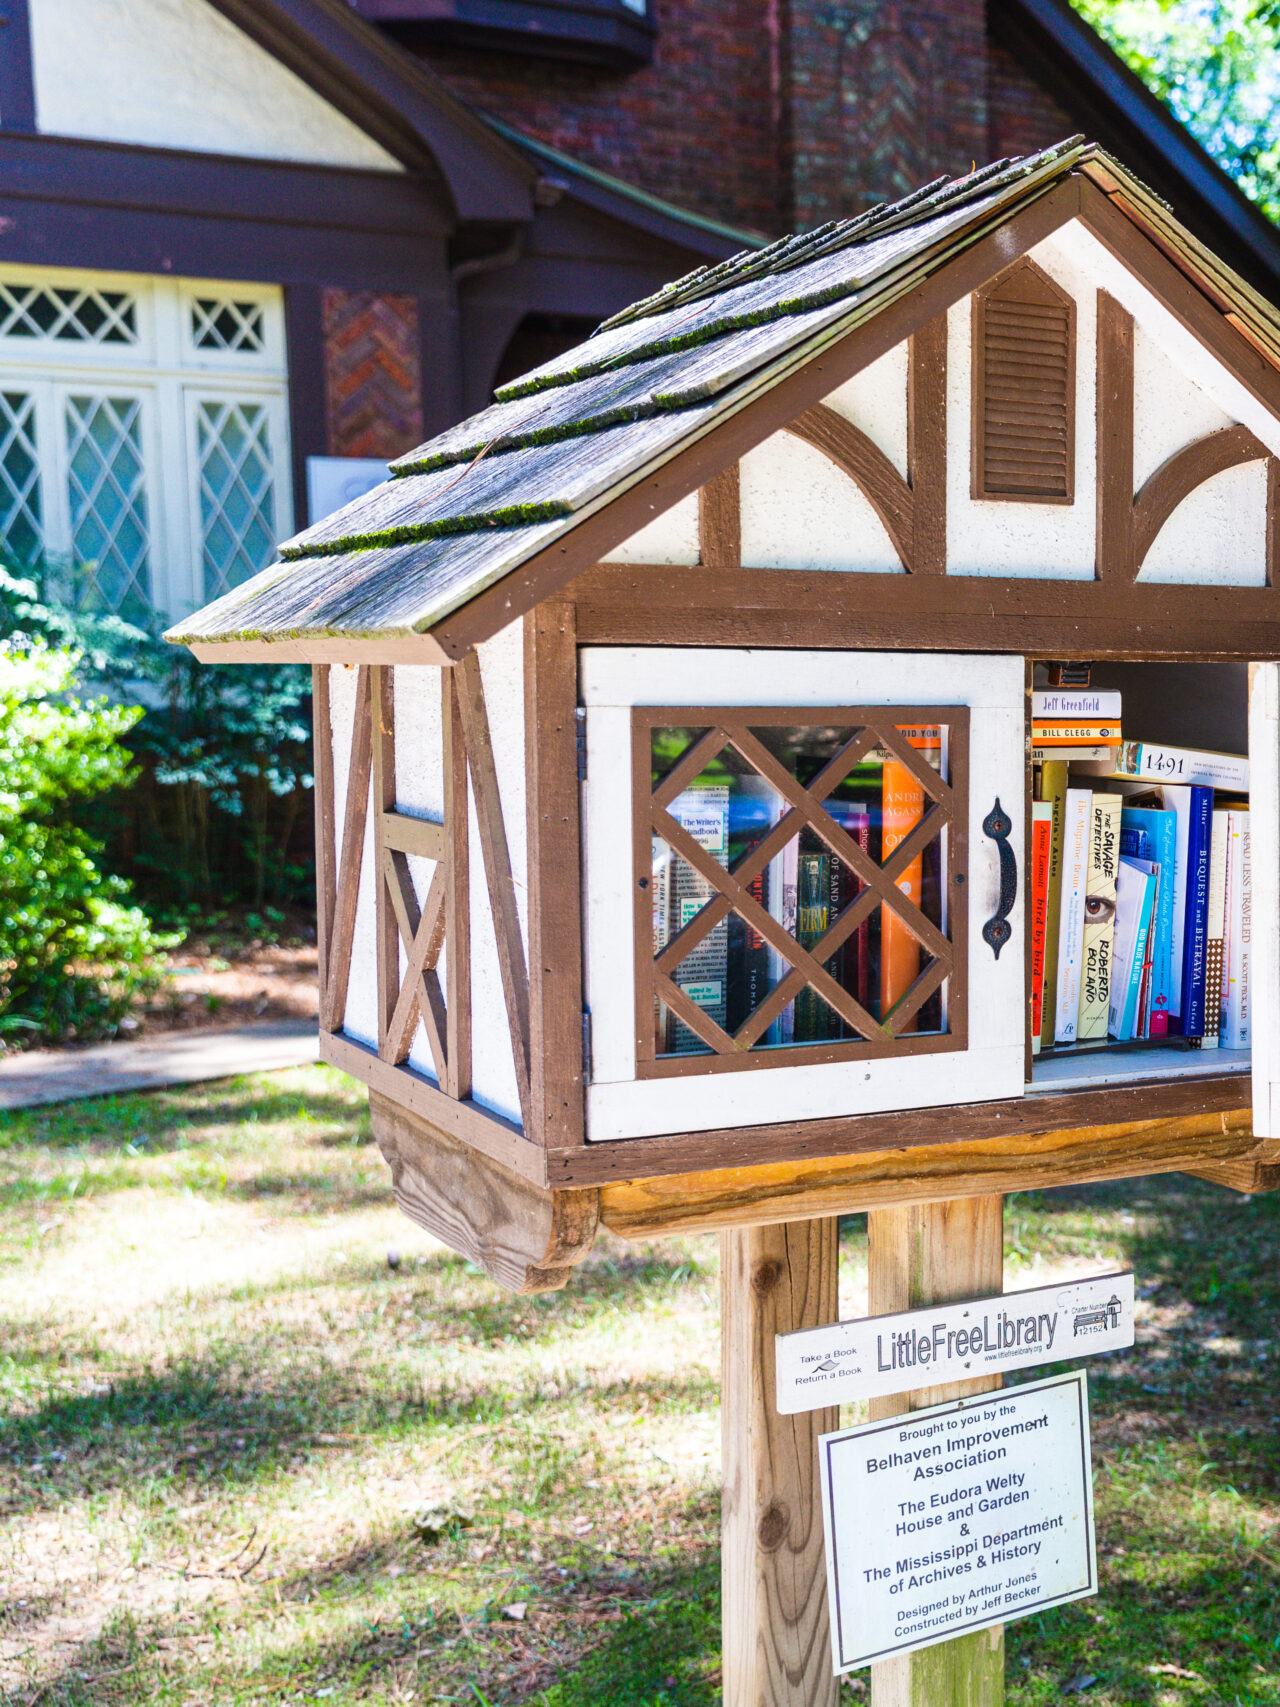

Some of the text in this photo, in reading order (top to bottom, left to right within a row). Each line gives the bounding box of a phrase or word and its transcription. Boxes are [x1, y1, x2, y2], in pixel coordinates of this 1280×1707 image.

[1043, 697, 1100, 711] Jeff Greenfield
[921, 729, 938, 738] YOU
[1042, 729, 1091, 737] BILL CLEGG
[1146, 753, 1184, 776] 1491
[1053, 796, 1061, 841] Angela's
[1094, 808, 1102, 870] DETECTIVES
[831, 857, 839, 871] OF
[1103, 831, 1115, 879] SAVAGE
[1038, 855, 1046, 888] Lamott
[1196, 850, 1206, 904] BEQUEST
[1242, 863, 1251, 887] LESS
[831, 874, 839, 902] SAND
[800, 905, 827, 932] FIRM
[1036, 899, 1045, 925] bird
[1241, 891, 1251, 944] TRAVELED
[1033, 929, 1043, 944] by
[1135, 942, 1145, 959] MADE
[1033, 950, 1042, 976] bird
[1098, 940, 1109, 1002] ROBERTO
[1131, 961, 1141, 984] NATURE
[1193, 927, 1203, 988] BETRAYAL
[1085, 948, 1098, 1003] BOLAÑO
[1072, 1302, 1107, 1314] Charter Number
[877, 1312, 1058, 1372] LittleFreeLibrary
[1079, 1326, 1103, 1336] 12152
[800, 1354, 822, 1364] Take
[833, 1347, 857, 1358] Book
[984, 1345, 1042, 1361] www.littlefreelibrary.org
[795, 1373, 827, 1385] Return
[838, 1366, 862, 1377] Book
[899, 1404, 1016, 1442] Brought to you by the
[866, 1414, 1049, 1474] Belhaven Improvement
[913, 1446, 1007, 1481] Association
[898, 1473, 1025, 1517] The Eudora Welty
[896, 1489, 1030, 1537] House and Garden
[960, 1522, 971, 1537] &
[863, 1514, 1064, 1583] The Mississippi Department
[889, 1541, 1042, 1595] of Archives & History
[894, 1584, 1041, 1637] Constructed by Jeff Becker
[897, 1572, 1038, 1622] Designed by Arthur Jones
